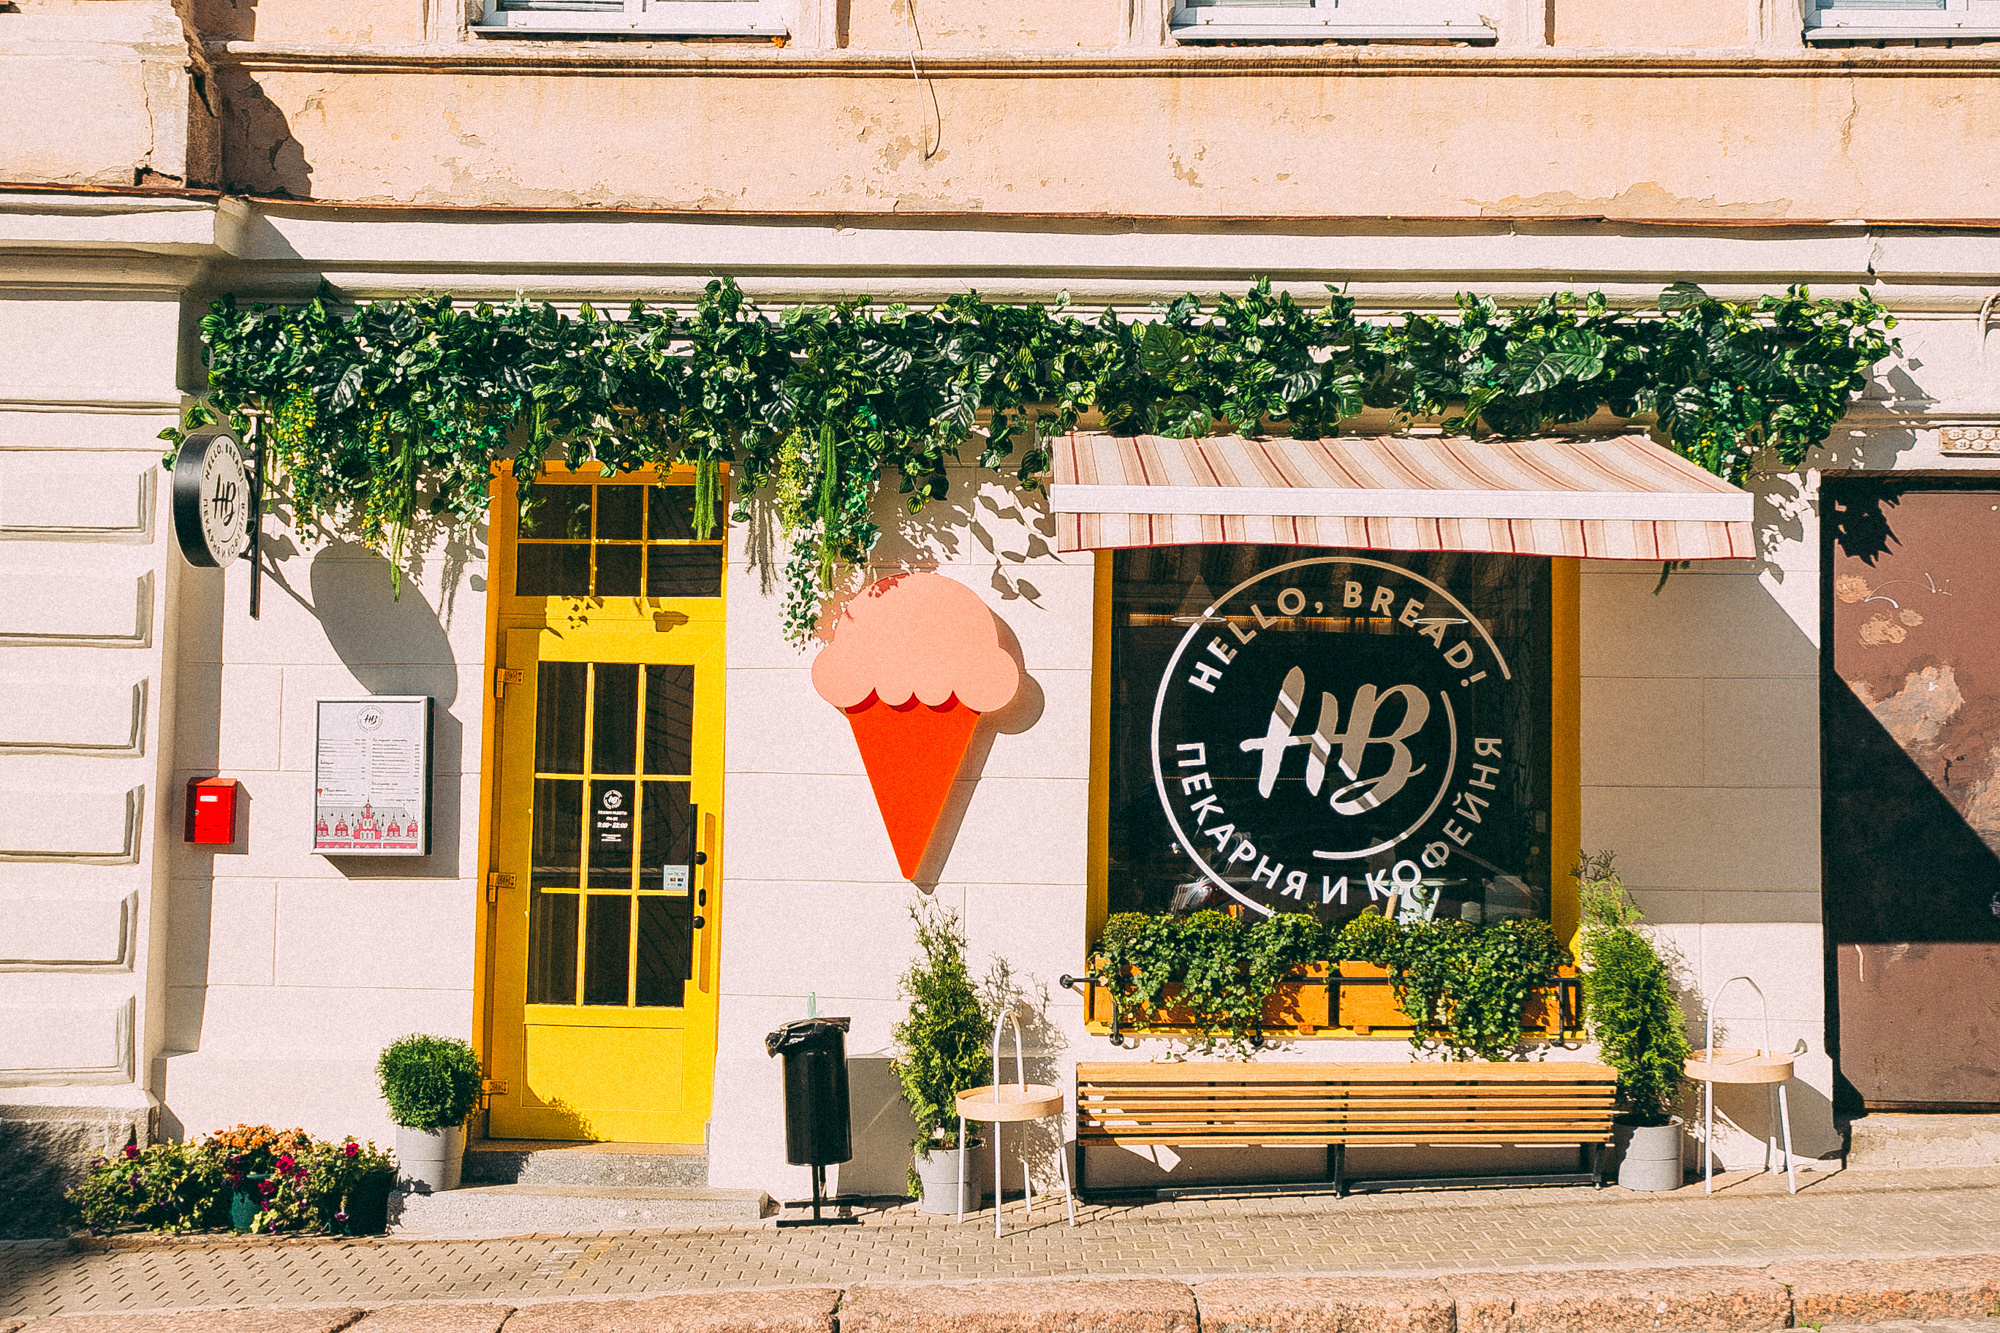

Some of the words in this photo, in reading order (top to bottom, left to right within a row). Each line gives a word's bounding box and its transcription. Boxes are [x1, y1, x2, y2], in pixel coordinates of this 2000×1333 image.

[204, 444, 224, 480] HELLO,
[226, 443, 244, 483] BREAD!
[1188, 587, 1324, 693] HELLO,
[1343, 580, 1487, 687] BREAD!
[1176, 741, 1308, 901] ПЕКАРНЯ
[1322, 875, 1348, 905] И
[1365, 737, 1503, 901] КОФЕЙНЯ
